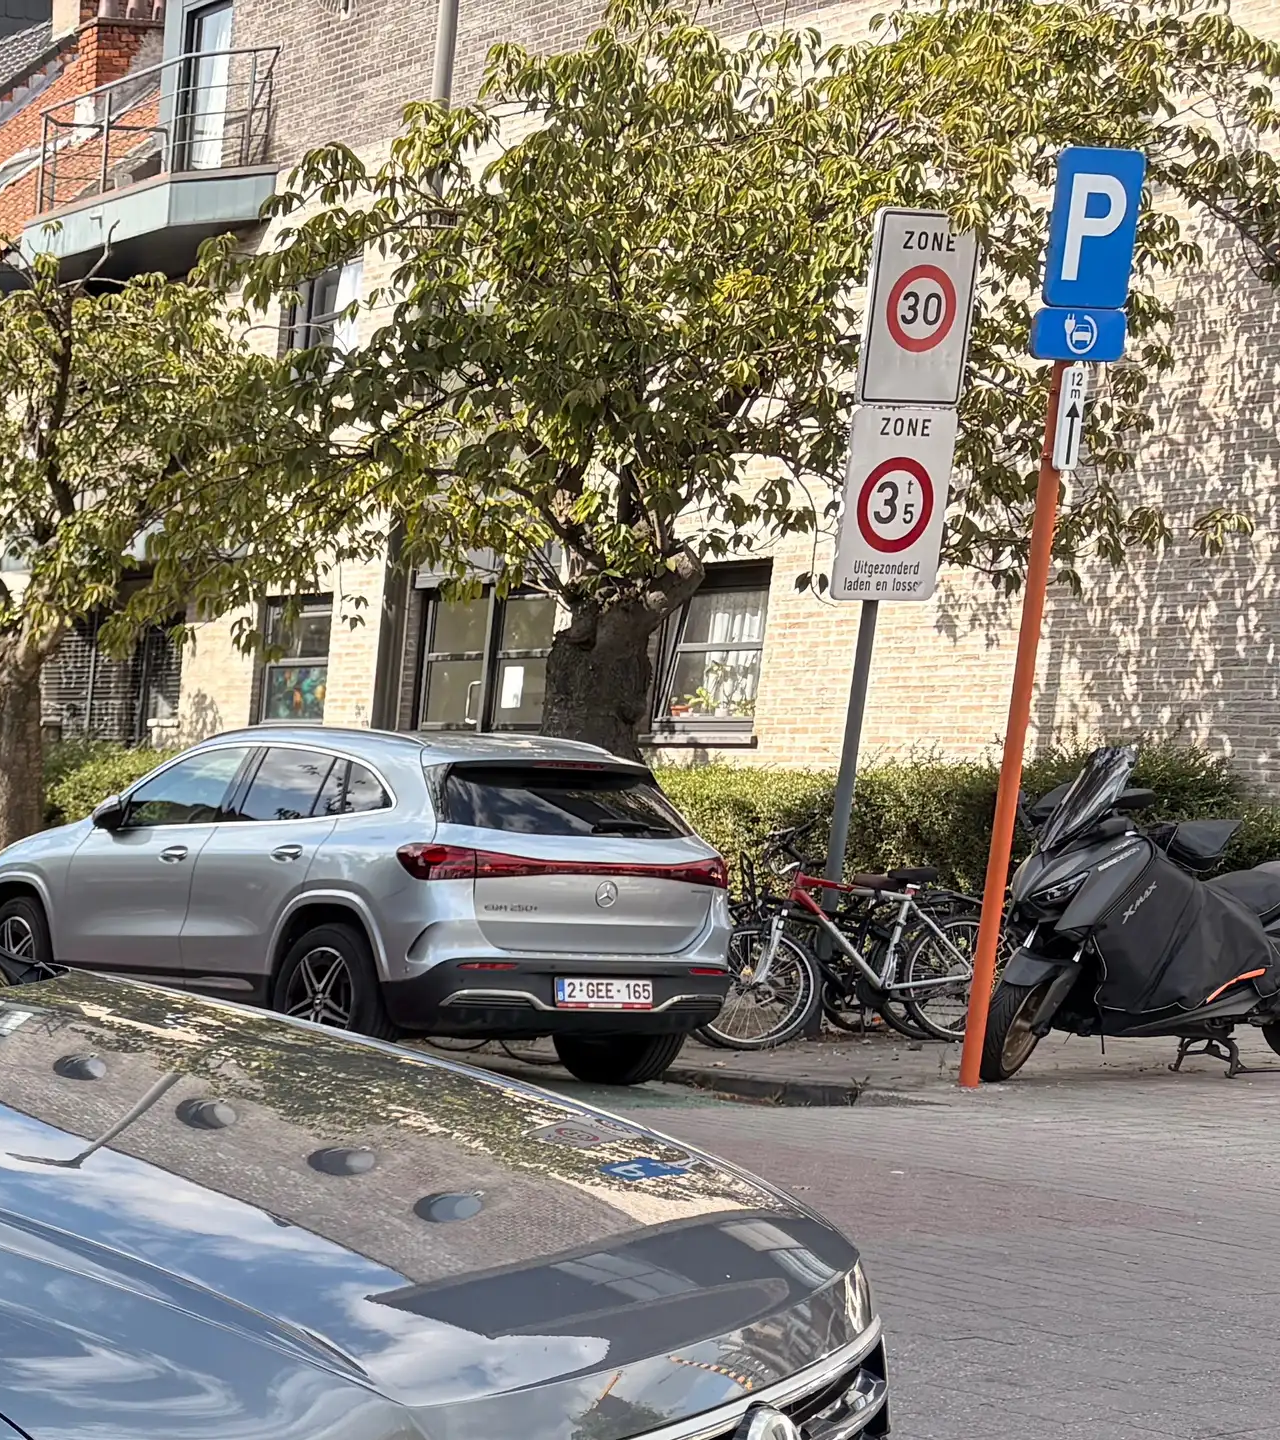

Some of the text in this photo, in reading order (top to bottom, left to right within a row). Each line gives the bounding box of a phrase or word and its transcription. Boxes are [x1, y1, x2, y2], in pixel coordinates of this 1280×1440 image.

[1061, 173, 1127, 281] P
[903, 231, 957, 252] ZONE
[901, 291, 942, 326] 30
[1071, 372, 1083, 387] 12
[1070, 389, 1081, 399] m
[880, 417, 932, 437] ZONE
[853, 560, 920, 578] Uitgezonderd
[843, 577, 871, 591] laden
[875, 580, 888, 591] en
